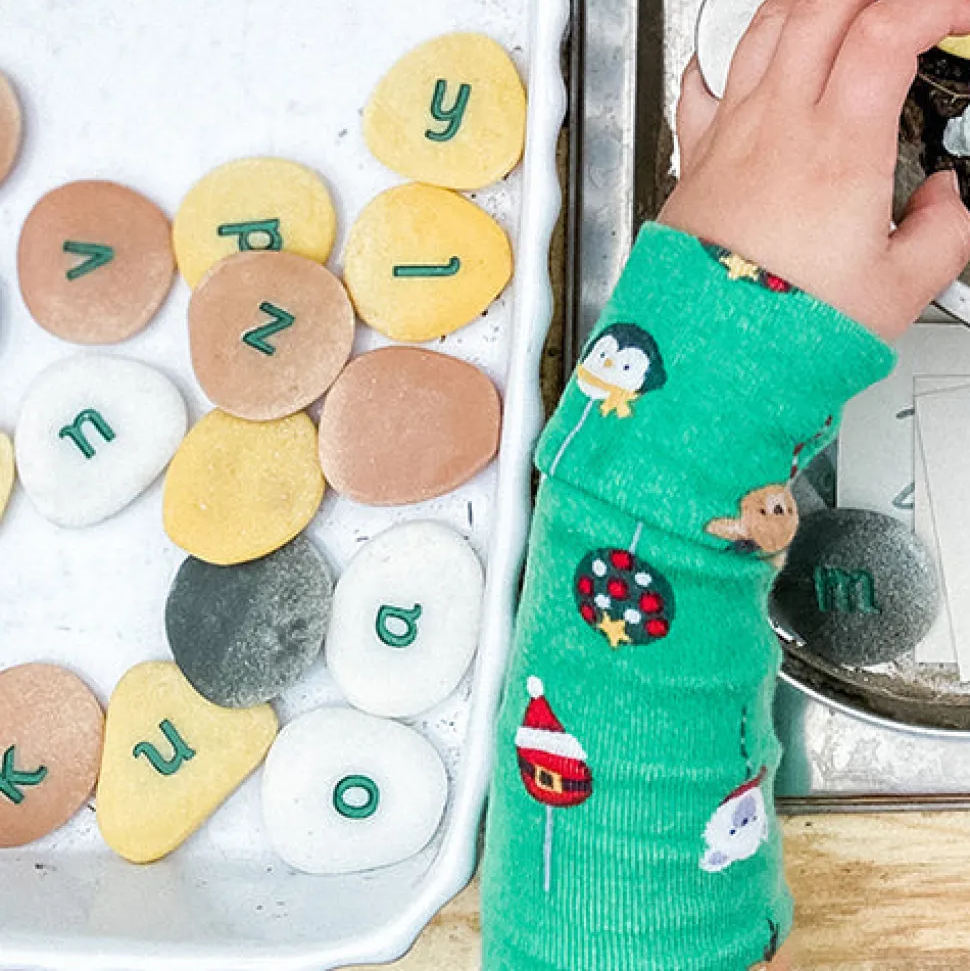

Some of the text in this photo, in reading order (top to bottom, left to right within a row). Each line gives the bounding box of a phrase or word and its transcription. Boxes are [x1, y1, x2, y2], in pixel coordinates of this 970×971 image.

[424, 78, 471, 142] y
[57, 407, 117, 459] n
[812, 564, 884, 616] m
[374, 602, 423, 649] a
[132, 718, 196, 776] u
[0, 744, 48, 805] k
[332, 774, 381, 820] o
